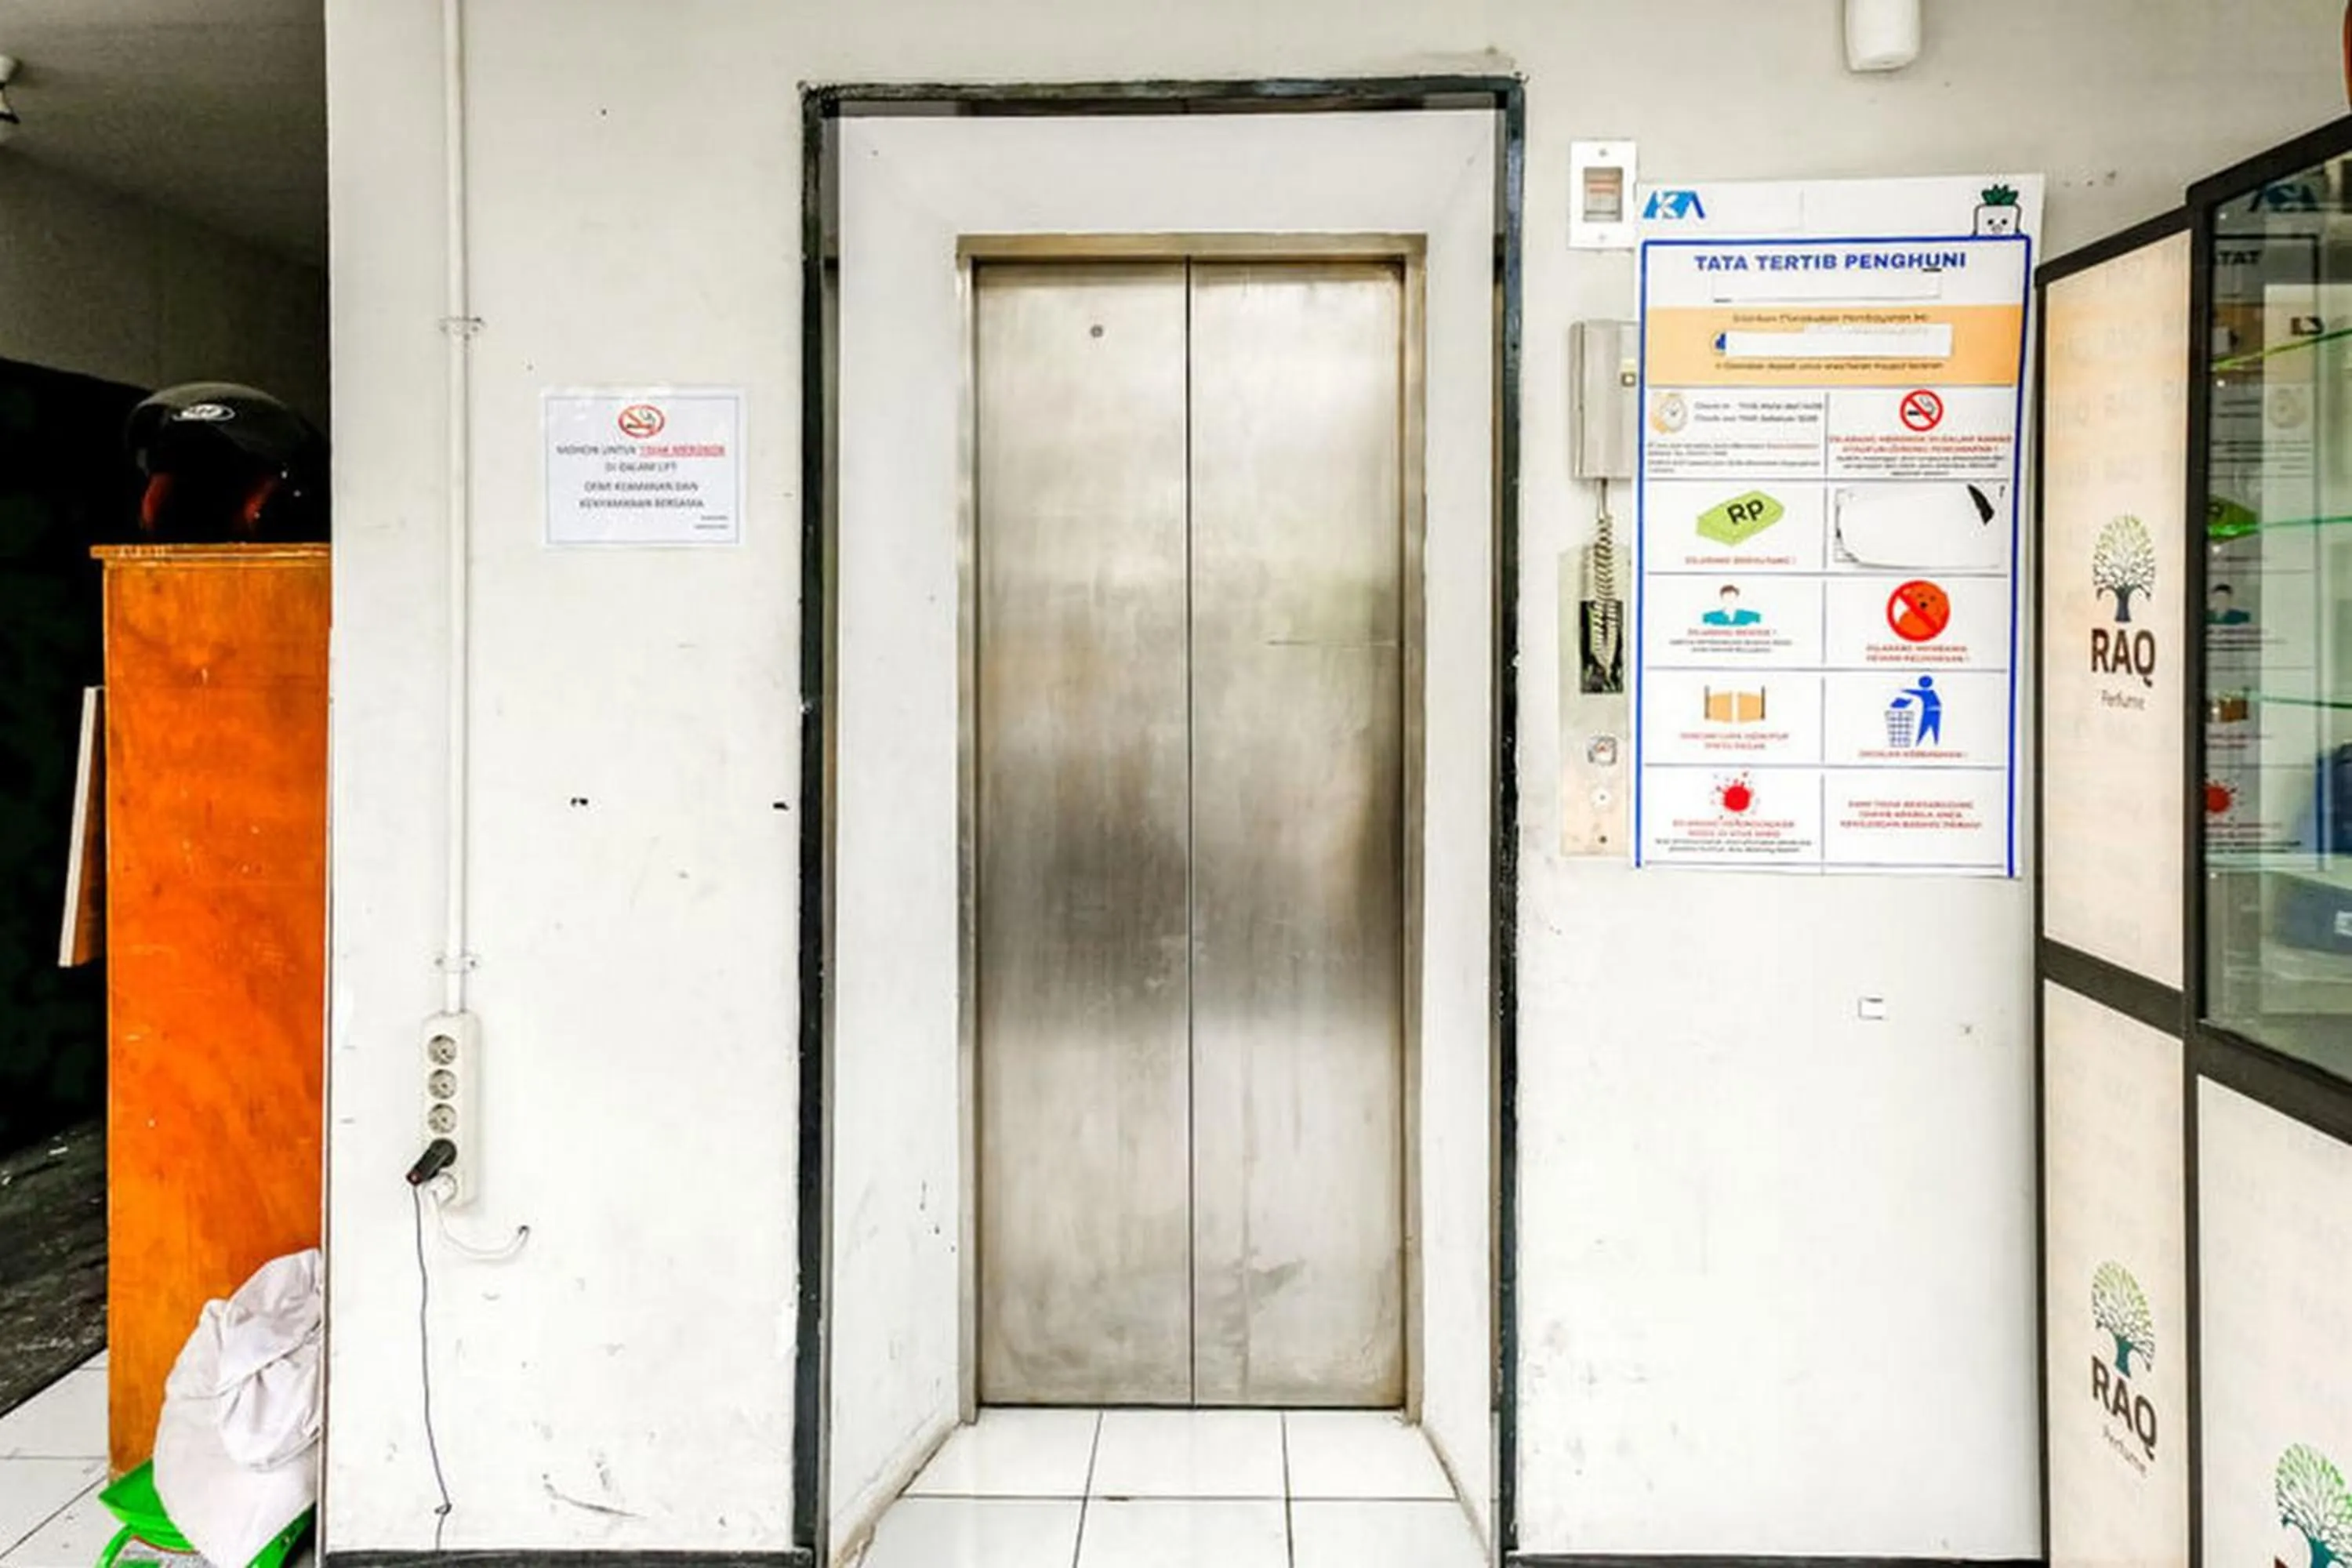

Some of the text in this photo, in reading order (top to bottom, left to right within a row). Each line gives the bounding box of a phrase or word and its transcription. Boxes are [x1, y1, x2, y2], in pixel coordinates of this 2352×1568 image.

[1694, 252, 1966, 271] TATA TERTIB PENGHUNI
[557, 445, 725, 456] MOHON UNTUK TIDAK MEROKOK
[604, 462, 677, 471] DI DALAM LIFT
[584, 481, 699, 492] DEMI KEAMANAN DAN
[579, 499, 704, 509] KENYAMANAN BERSAMA
[2091, 628, 2156, 688] RAQ
[2101, 690, 2146, 710] Perfume
[2091, 1355, 2158, 1462] RAQ
